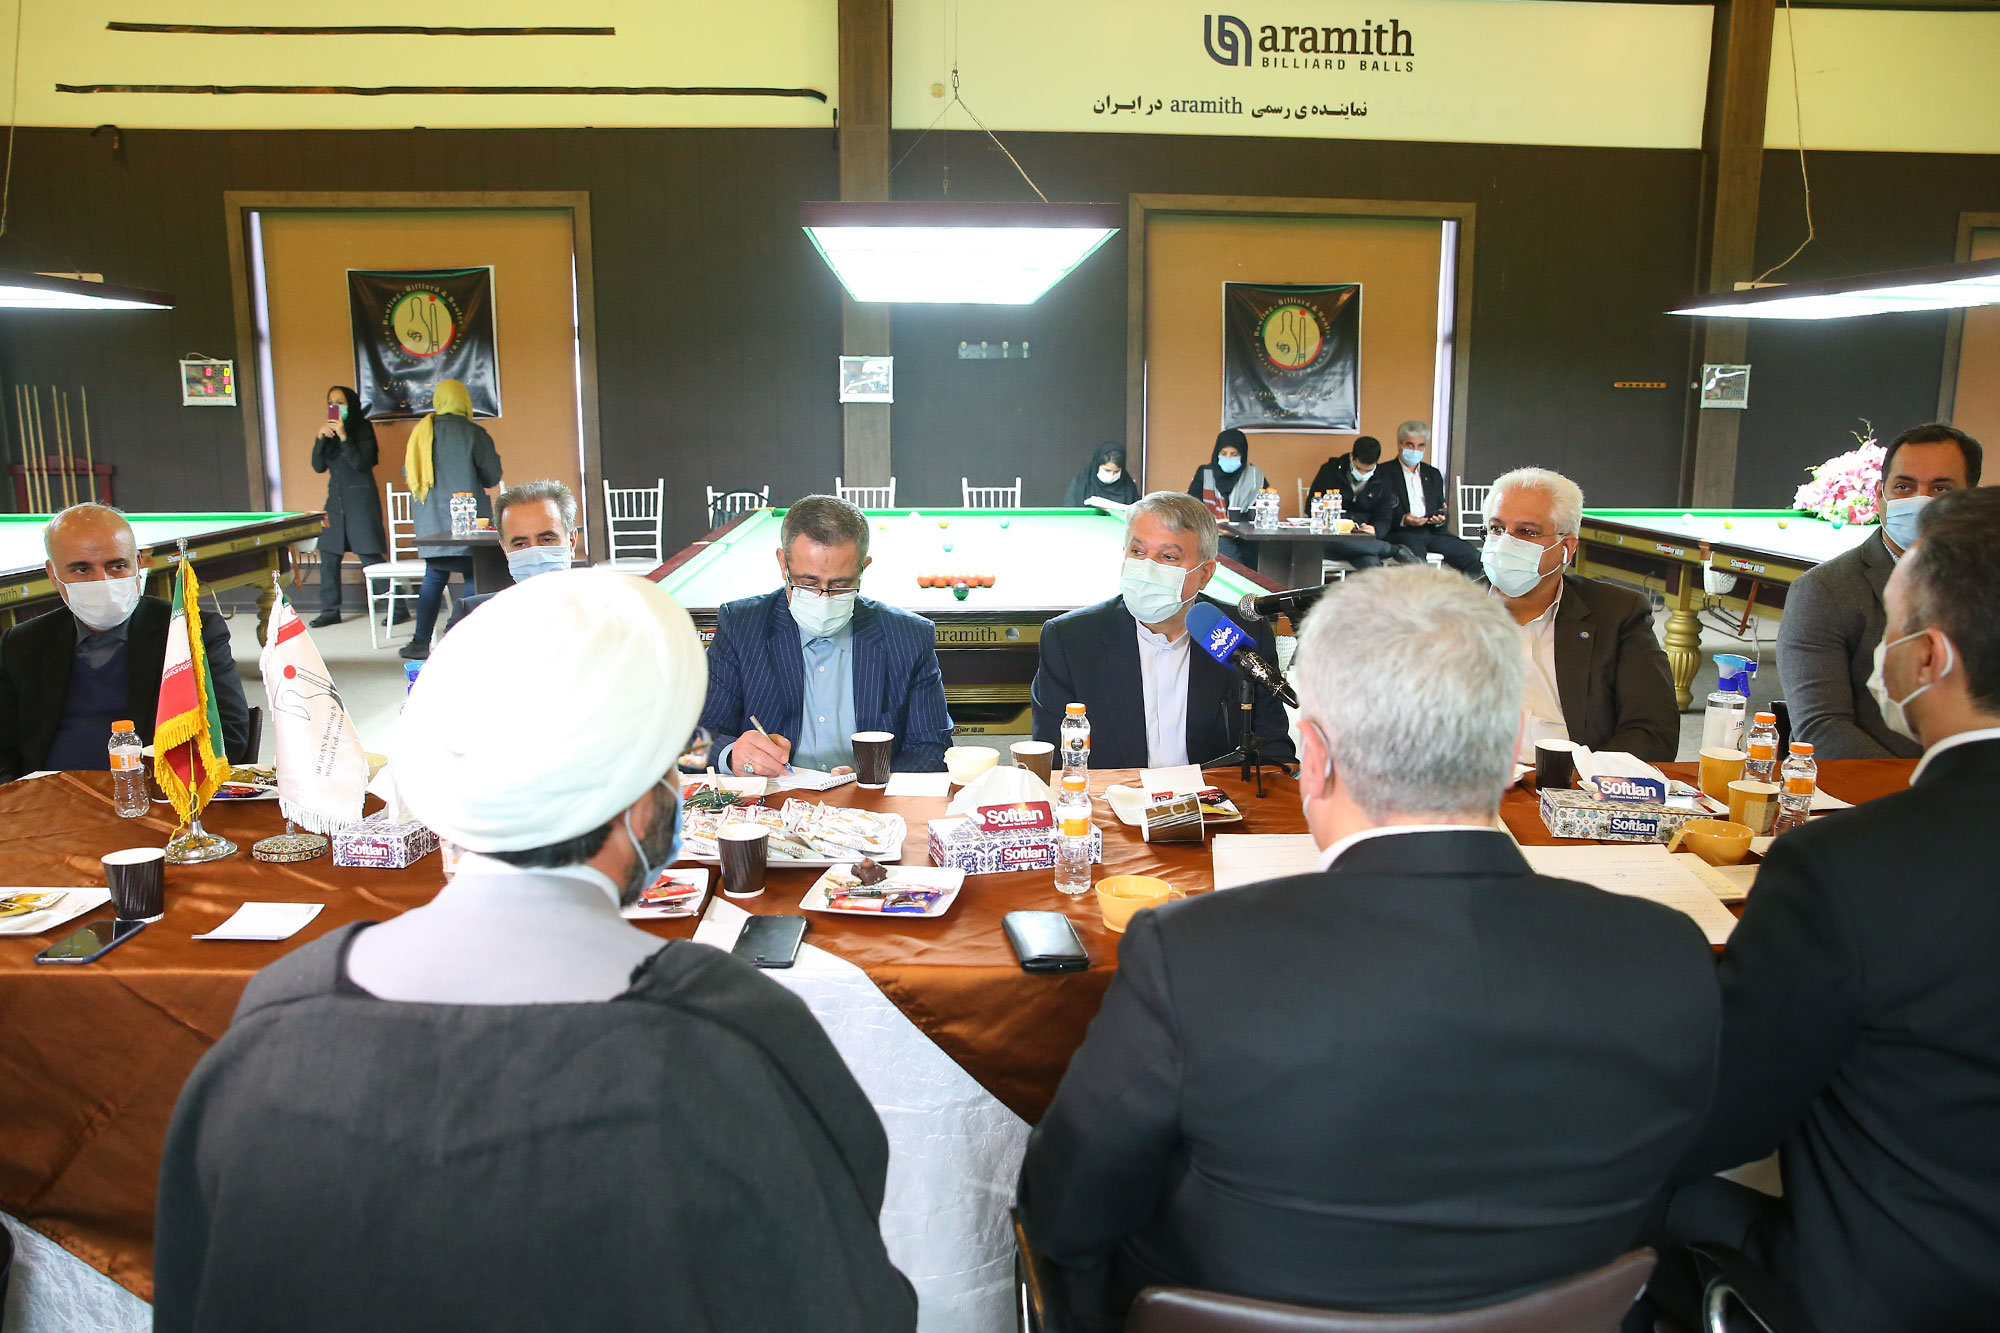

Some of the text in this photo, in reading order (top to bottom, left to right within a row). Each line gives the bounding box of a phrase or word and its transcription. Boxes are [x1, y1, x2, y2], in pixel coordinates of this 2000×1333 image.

[1258, 19, 1415, 57] aramith
[1261, 57, 1414, 73] BILLIARD BALLS
[1093, 94, 1142, 115] ایران
[1144, 98, 1163, 115] در
[1170, 96, 1243, 114] aramith
[1251, 103, 1291, 119] رسمی
[1600, 780, 1657, 798] Softlan
[986, 807, 1044, 825] Softlan
[1612, 818, 1656, 832] Softlan
[346, 843, 388, 857] Softlan
[1003, 847, 1047, 861] Softlan
